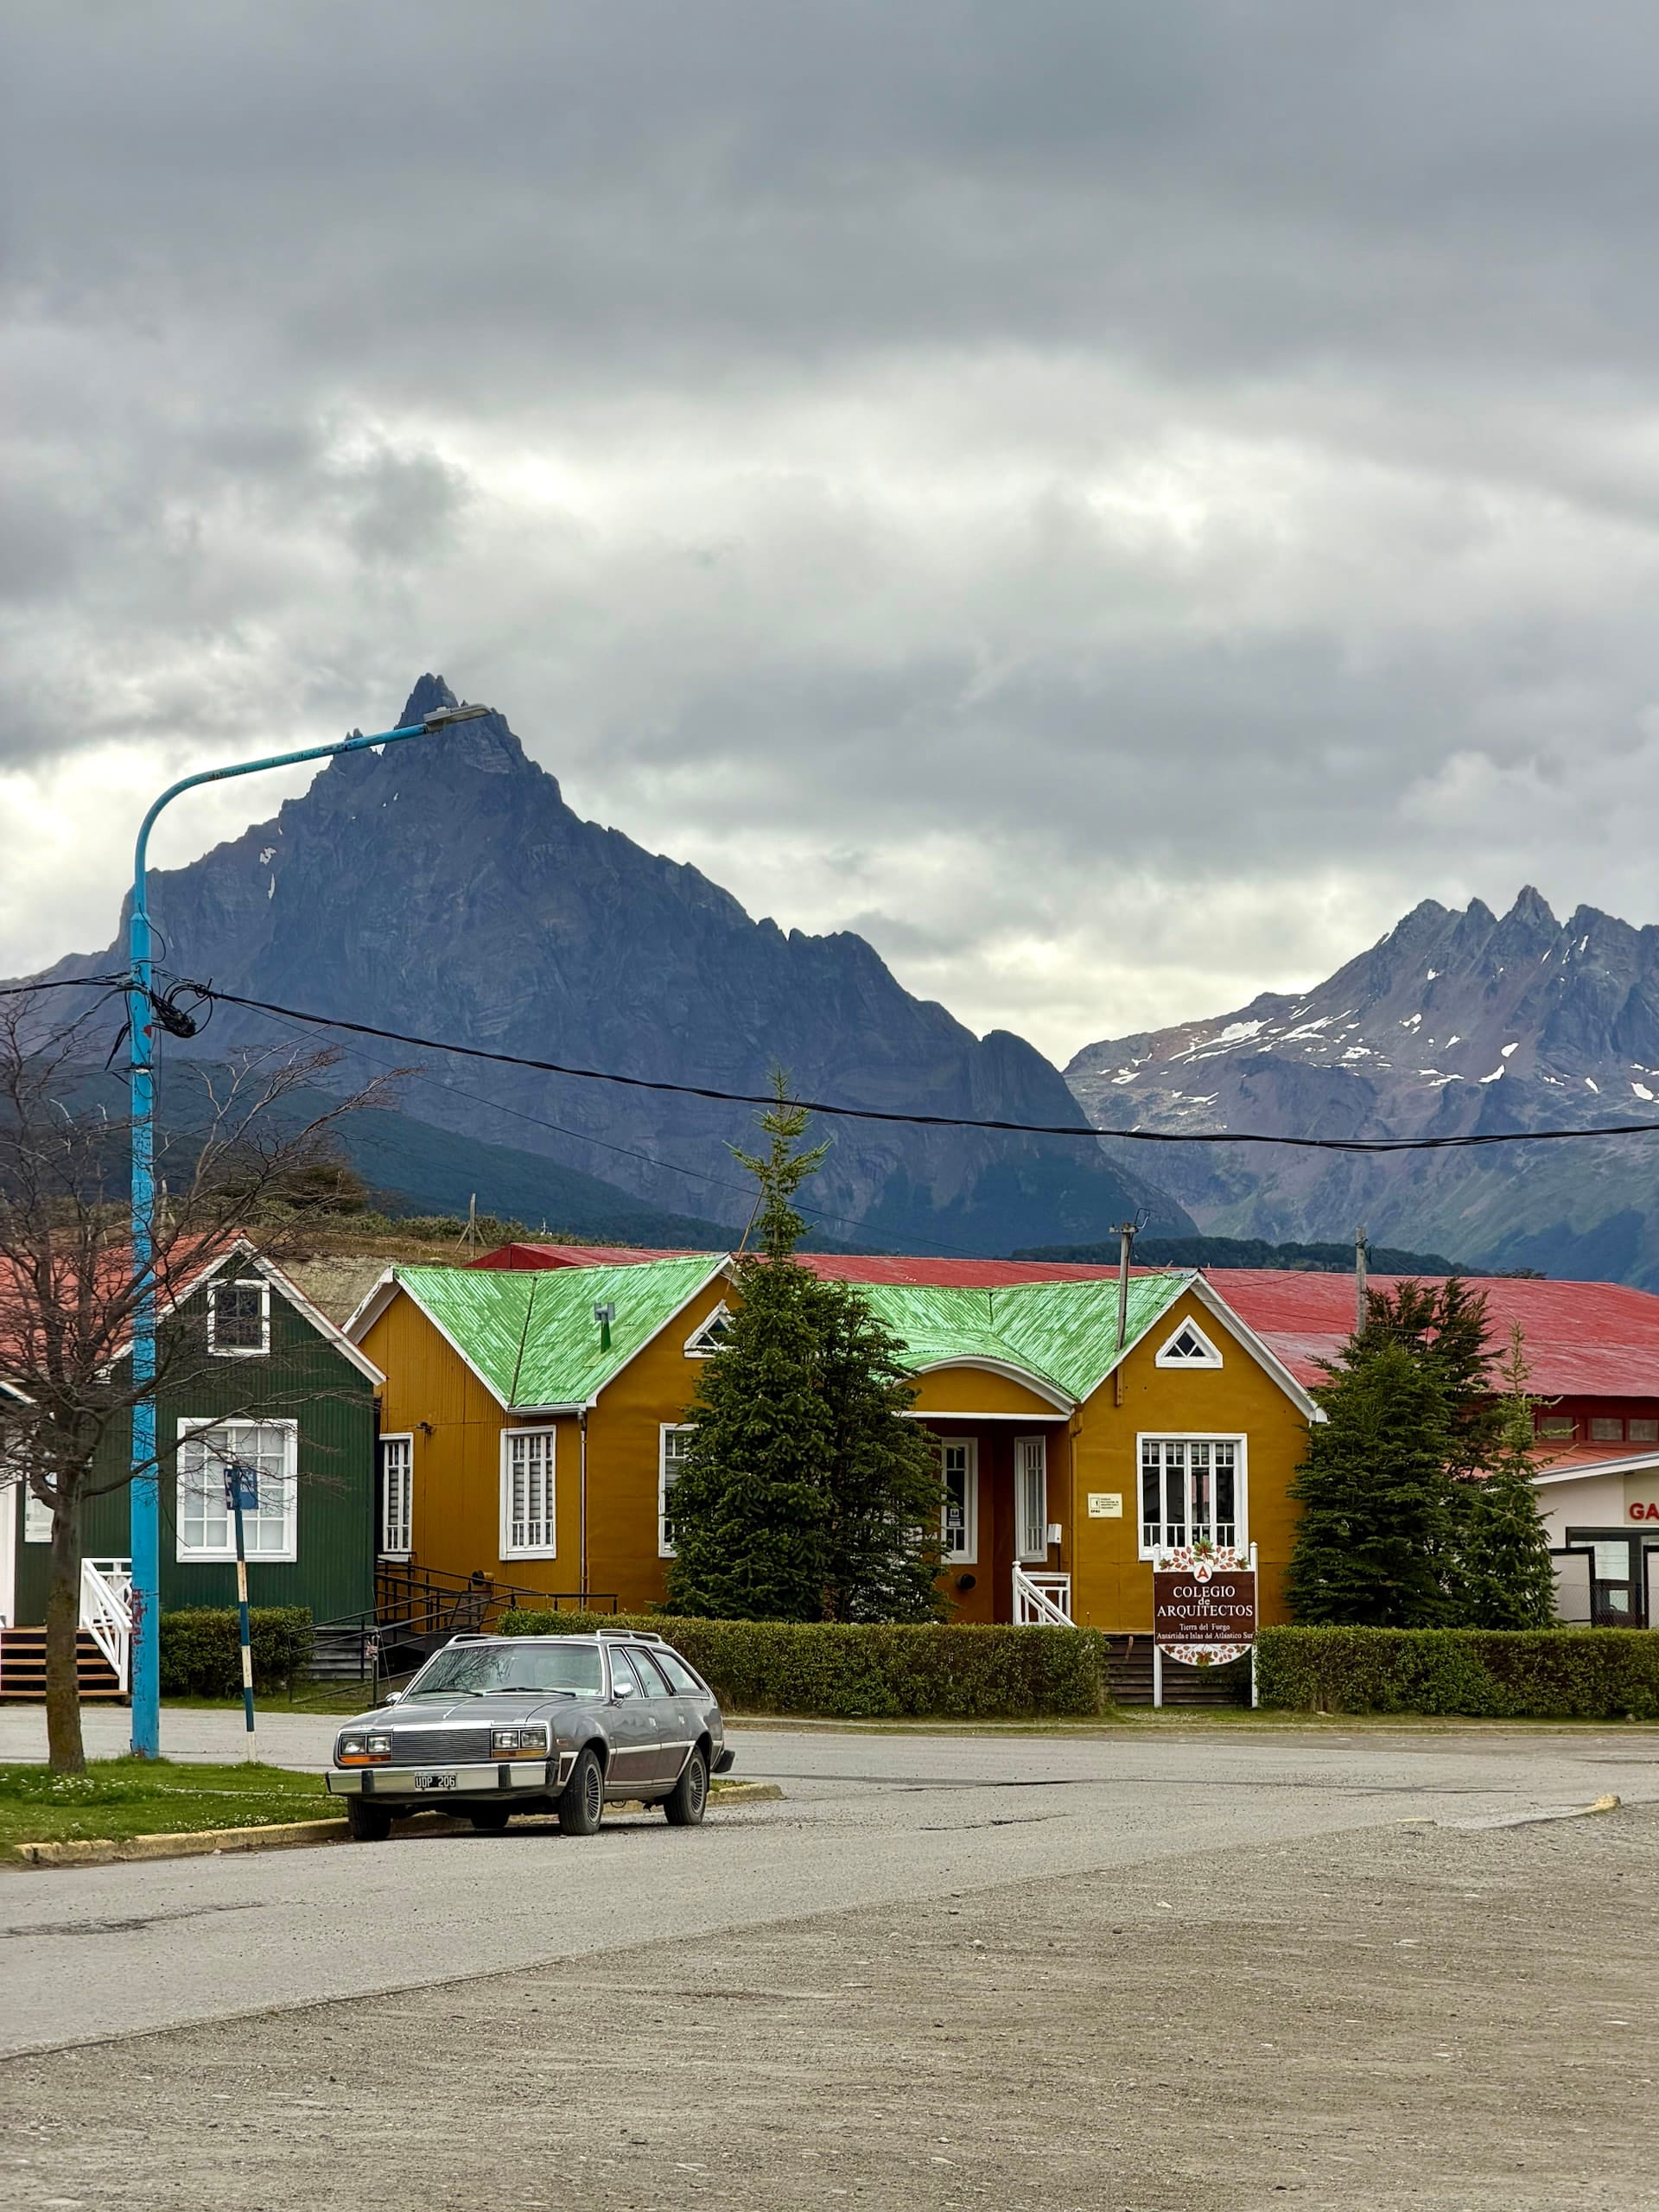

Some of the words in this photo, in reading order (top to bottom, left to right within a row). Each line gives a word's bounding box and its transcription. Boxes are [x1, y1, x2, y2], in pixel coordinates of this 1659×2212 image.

[1629, 1503, 1659, 1520] GA
[1173, 1586, 1236, 1598] COLEGIO
[1198, 1597, 1211, 1605] de
[1157, 1605, 1253, 1618] ARQUITECTOS
[1211, 1623, 1230, 1632] Fuego
[1190, 1631, 1204, 1640] Islas
[1243, 1630, 1254, 1639] Sur
[416, 1777, 433, 1788] UDP
[437, 1776, 455, 1787] 206
